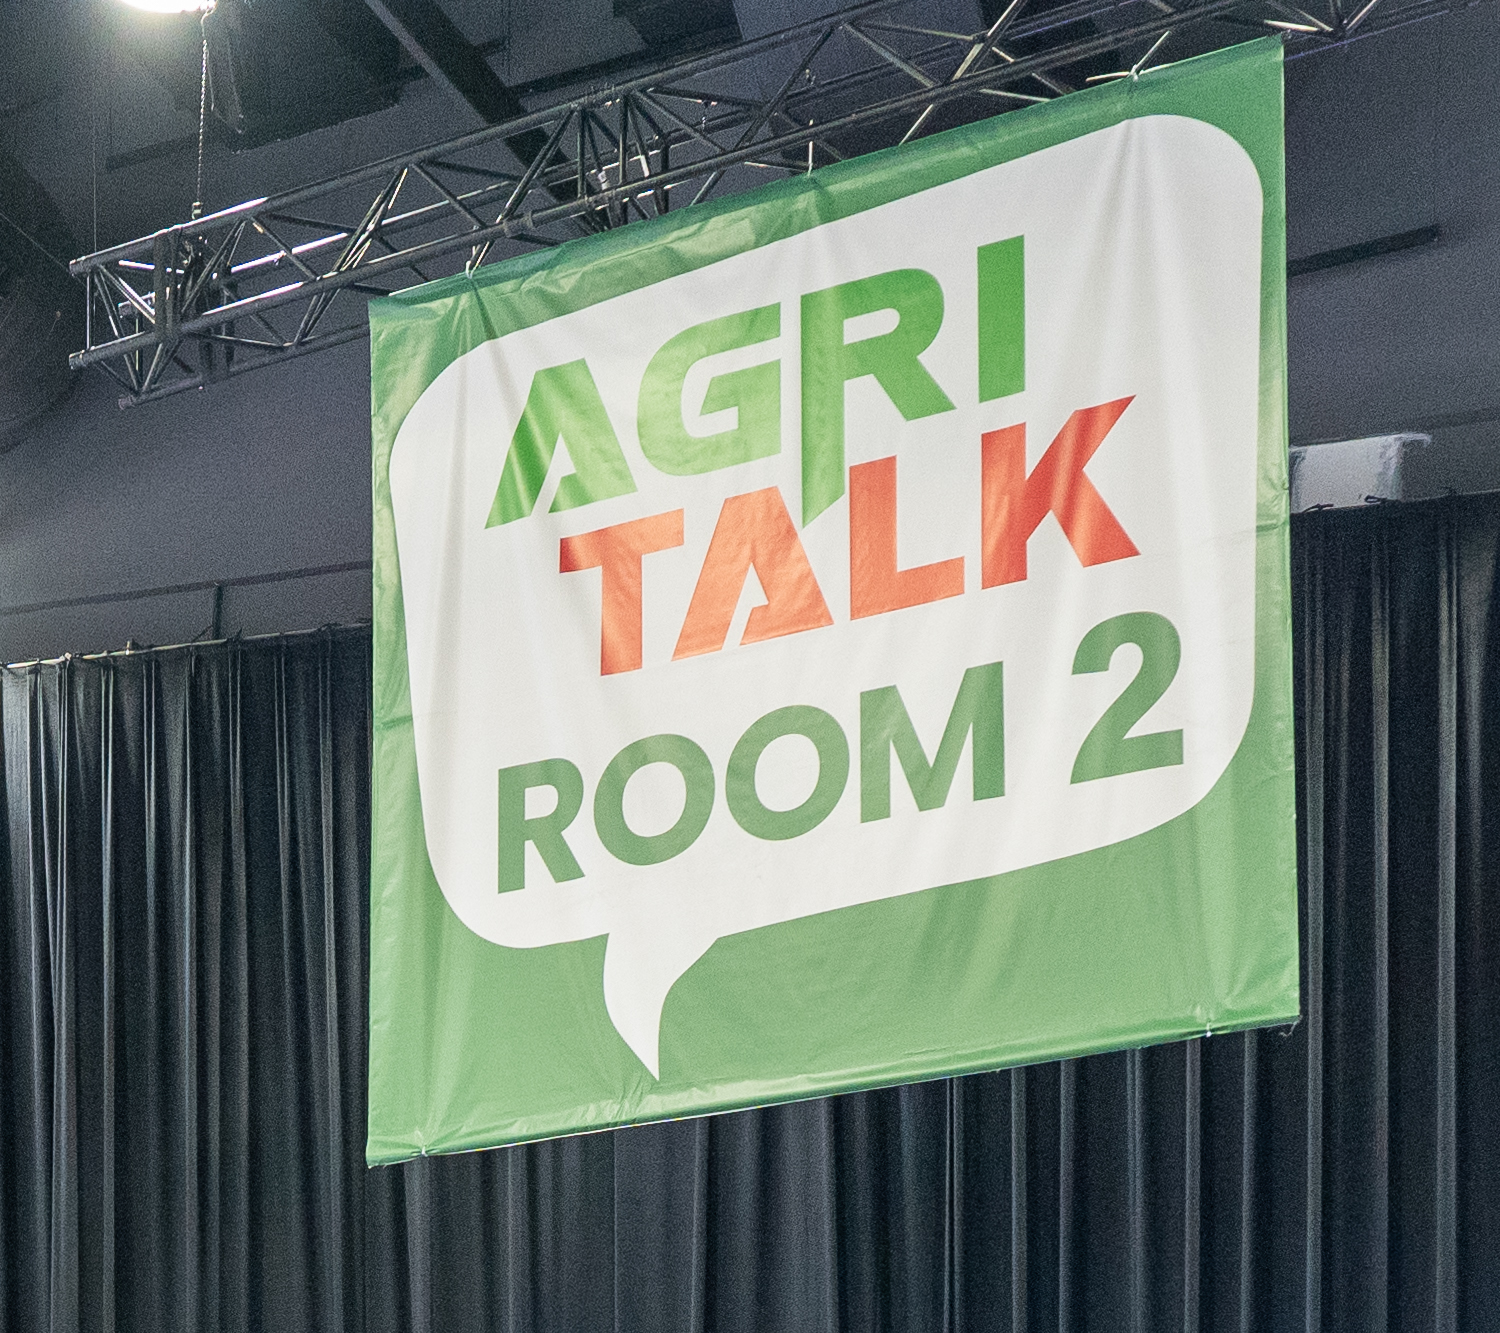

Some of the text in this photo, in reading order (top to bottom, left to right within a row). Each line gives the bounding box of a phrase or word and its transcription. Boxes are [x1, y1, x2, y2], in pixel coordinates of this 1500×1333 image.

[484, 234, 1026, 530] AGRI
[558, 394, 1141, 677] TALK
[496, 610, 1185, 895] ROOM 2
